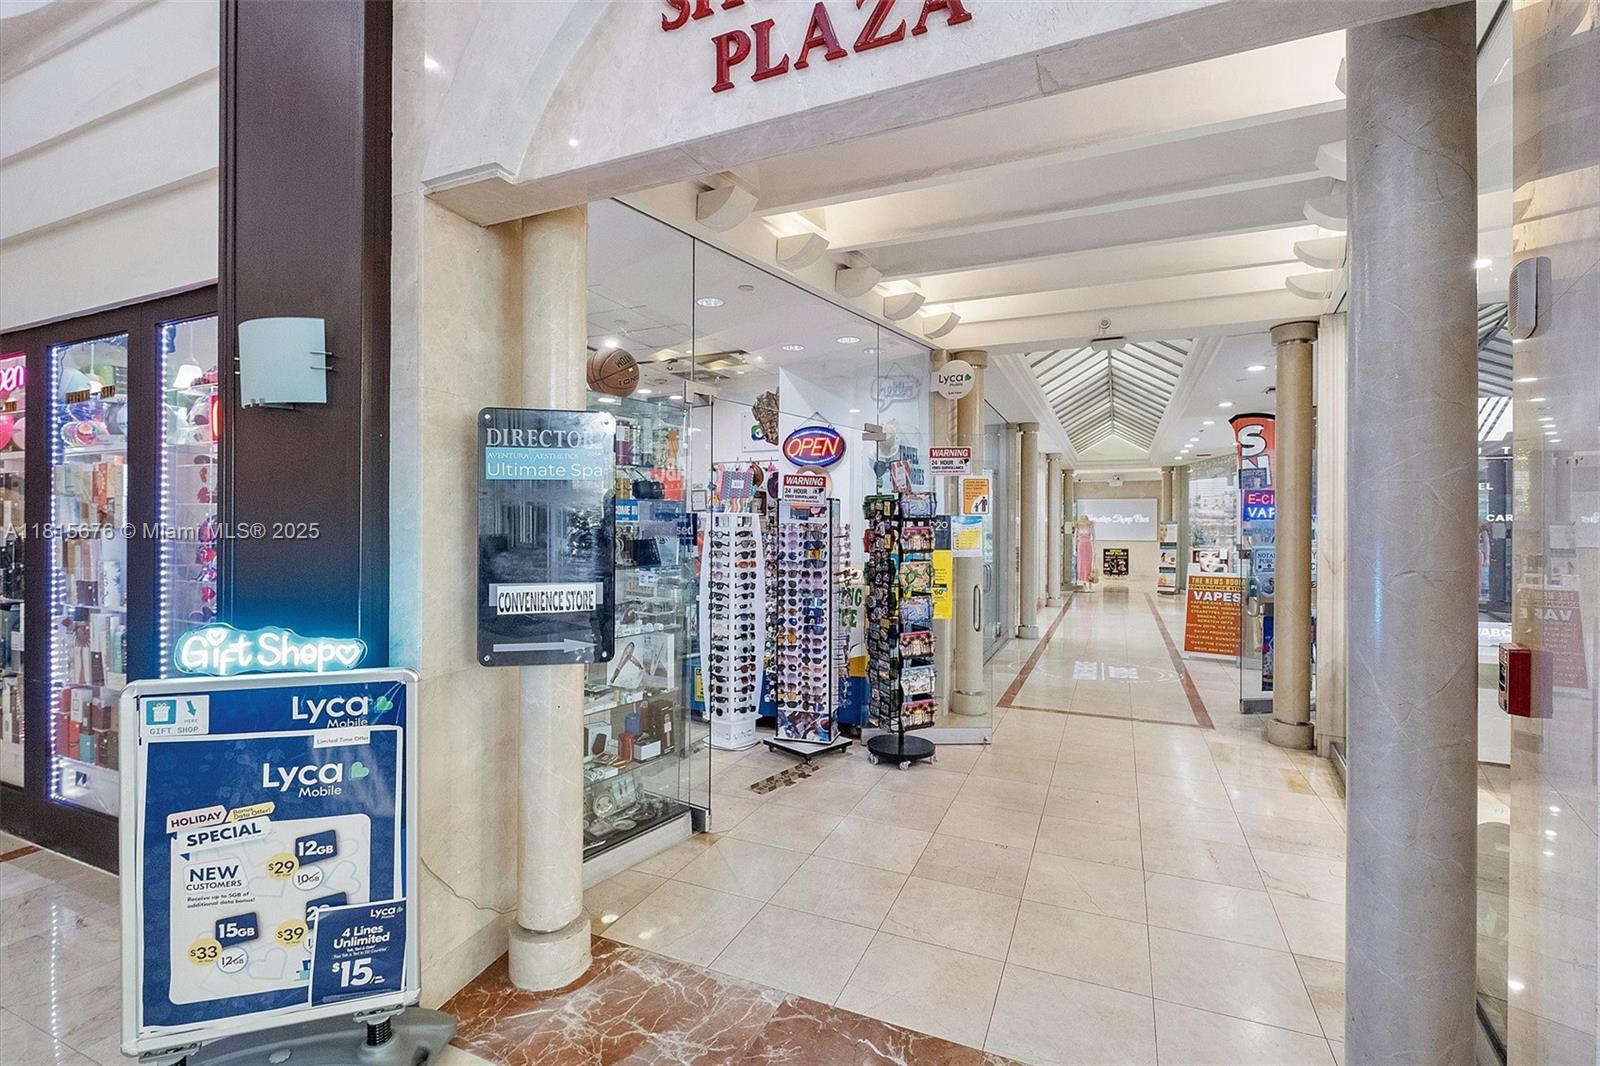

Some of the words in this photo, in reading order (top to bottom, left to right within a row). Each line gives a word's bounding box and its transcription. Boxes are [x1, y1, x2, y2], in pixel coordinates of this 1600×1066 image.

[711, 0, 973, 93] PLAZA
[938, 374, 964, 385] Lyca
[787, 437, 839, 457] OPEN
[931, 449, 969, 457] WARNING
[487, 462, 566, 477] Ultimate
[570, 463, 603, 479] Spa
[785, 476, 824, 486] WARNING
[1248, 494, 1274, 505] E-CI
[498, 590, 564, 613] CONVENIENCE
[565, 589, 595, 611] STORE
[1193, 591, 1242, 603] VAPES
[181, 630, 254, 675] Gift
[257, 632, 337, 673] Shop
[292, 695, 370, 723] Lyca
[176, 726, 199, 734] SHOP
[327, 717, 369, 729] Mobile
[262, 762, 343, 792] Lyca
[298, 786, 343, 799] Mobile
[170, 811, 222, 828] HOLIDAY
[233, 812, 251, 820] Data
[186, 822, 262, 847] SPECIAL
[297, 840, 334, 857] 12GB
[189, 864, 239, 882] NEW
[268, 860, 295, 875] $29
[185, 880, 243, 892] CUSTOMERS
[370, 906, 396, 919] Lyca
[218, 922, 256, 939] 15GB
[277, 926, 305, 942] $39
[341, 927, 351, 938] 4
[353, 924, 384, 937] Lines
[333, 931, 391, 950] Unlimited
[190, 945, 218, 960] $33
[331, 957, 374, 988] $15
